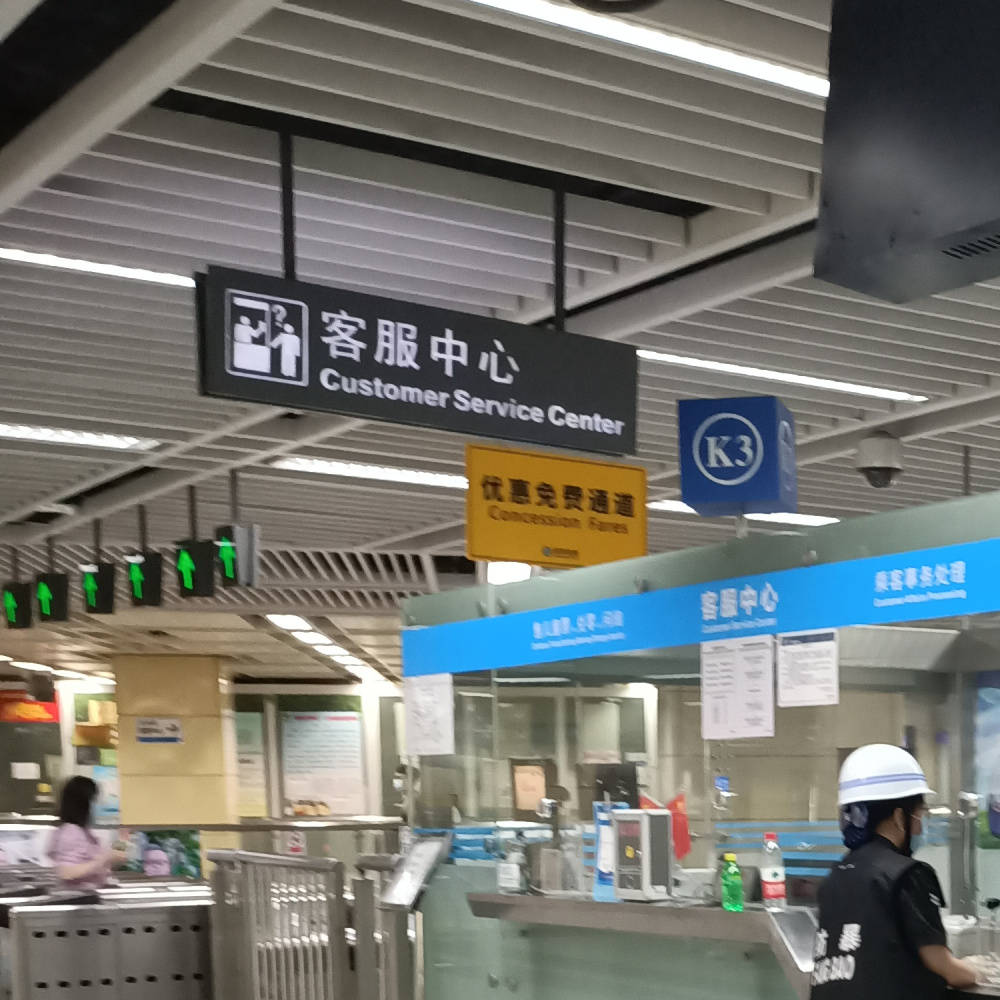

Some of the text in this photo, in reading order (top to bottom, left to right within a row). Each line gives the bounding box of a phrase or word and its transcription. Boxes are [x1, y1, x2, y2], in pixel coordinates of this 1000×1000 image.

[320, 310, 520, 385] 客服中心
[319, 367, 626, 436] Customer Service Center
[703, 434, 754, 468] K3
[481, 475, 635, 518] 优惠免费通道
[488, 505, 582, 529] Concession
[701, 582, 779, 621] 客服中心
